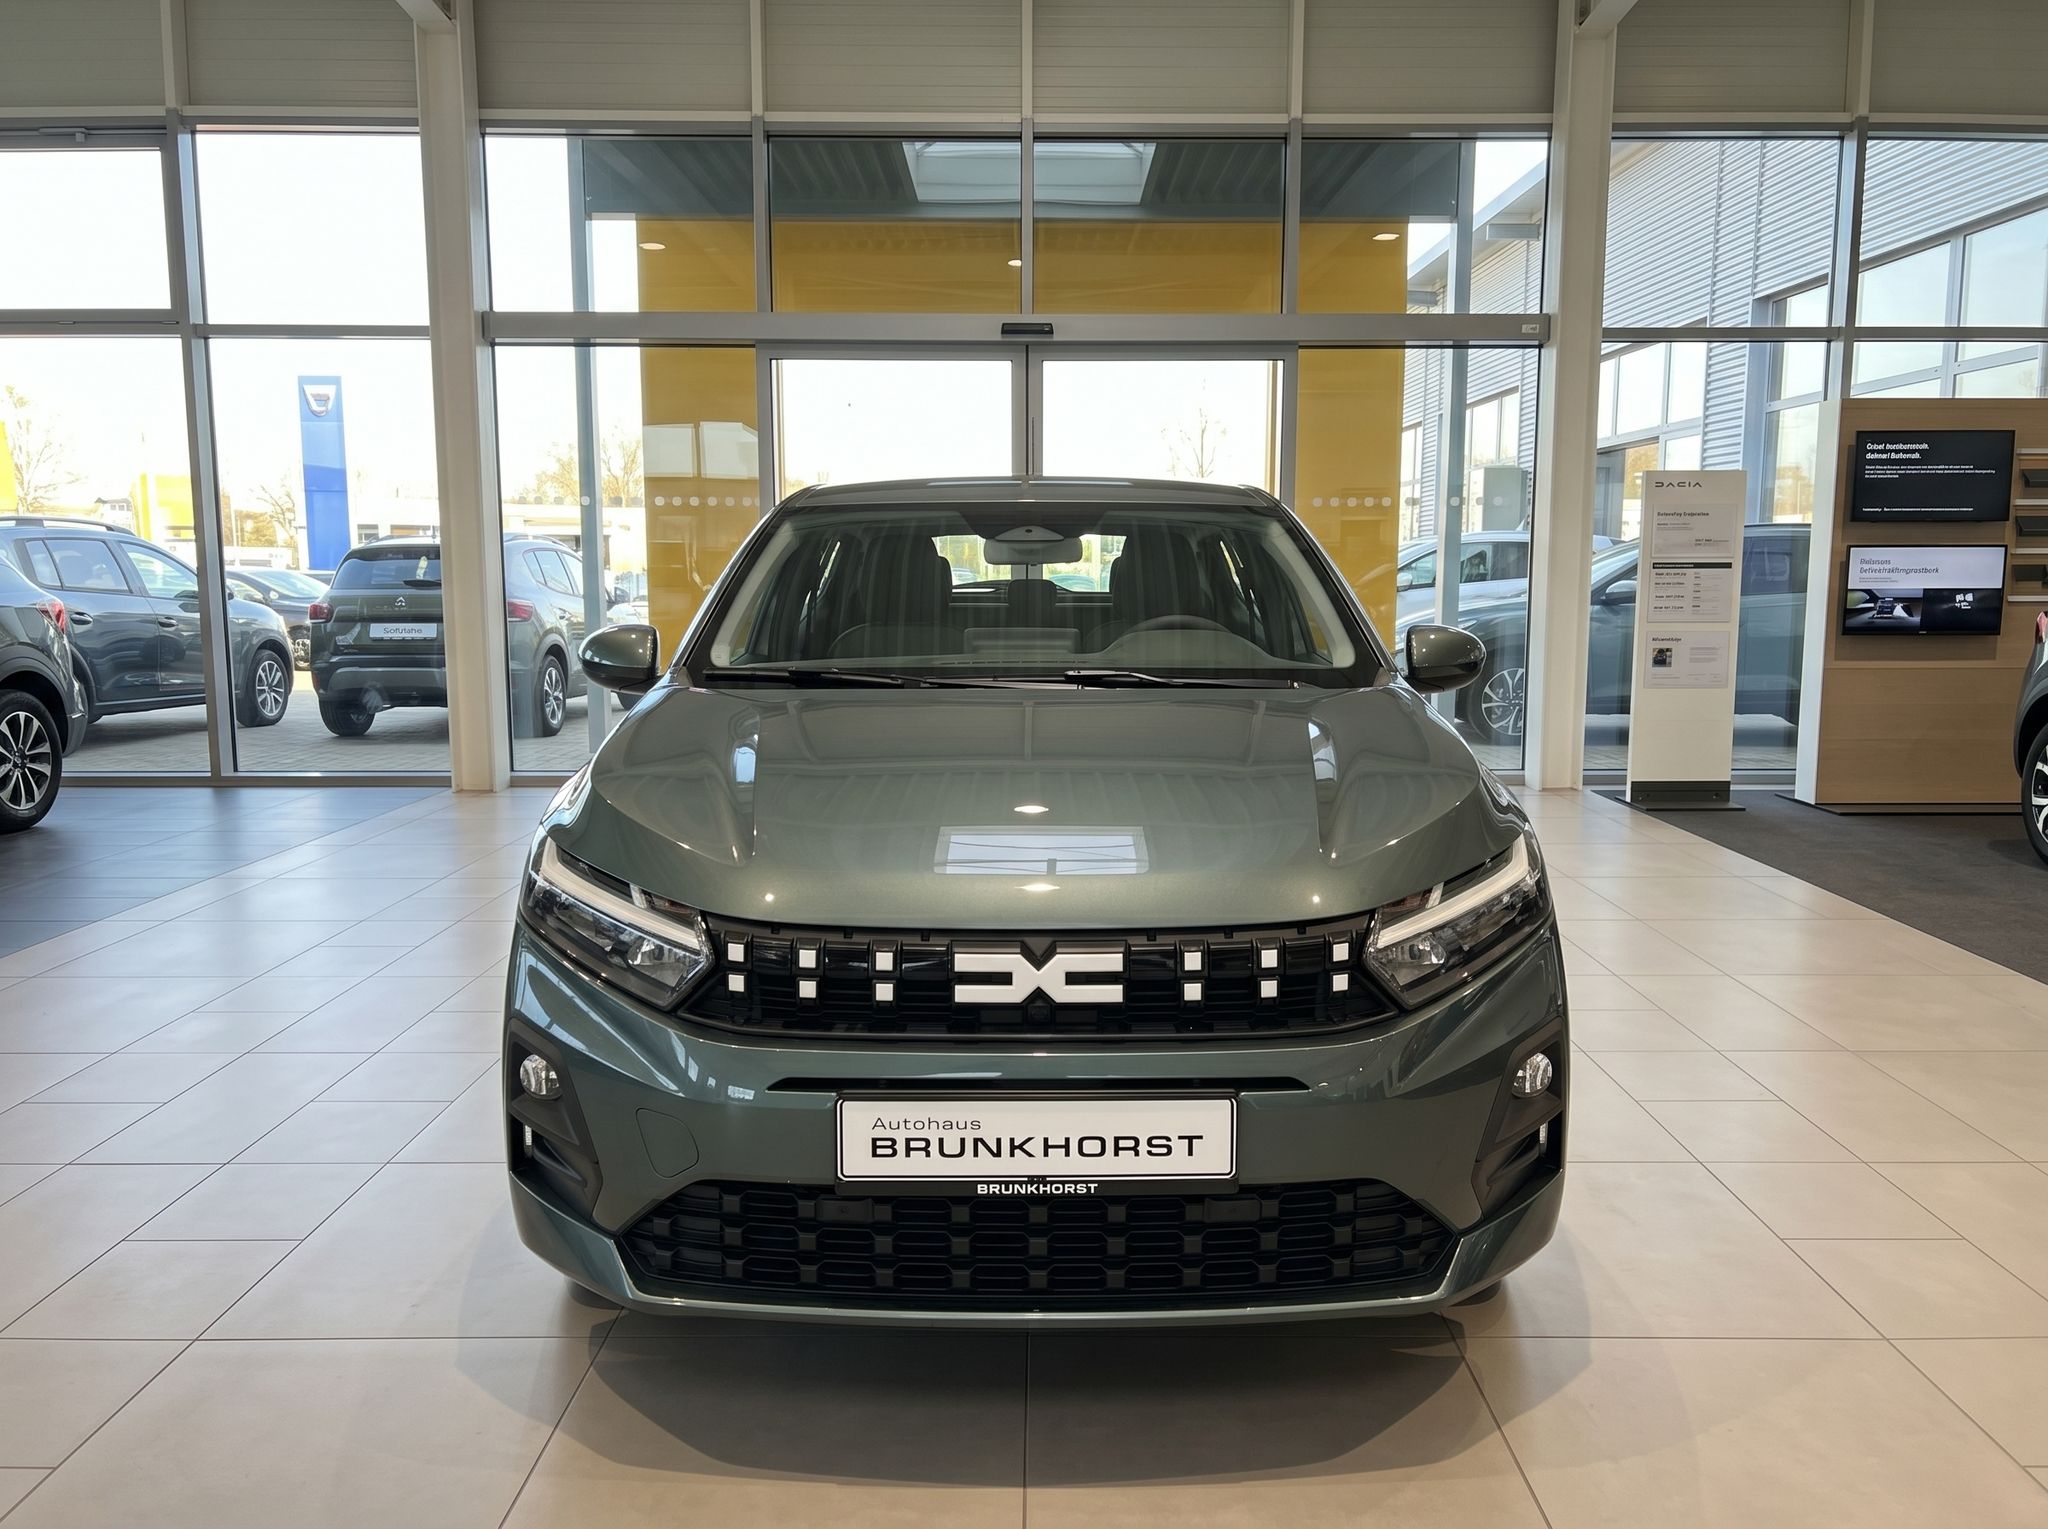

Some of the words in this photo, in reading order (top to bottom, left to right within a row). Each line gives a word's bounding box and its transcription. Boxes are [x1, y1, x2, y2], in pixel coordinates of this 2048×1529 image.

[871, 1117, 982, 1131] Autohaus
[871, 1135, 1204, 1159] BRUNKHORST
[977, 1183, 1098, 1194] BRUNKHORST
